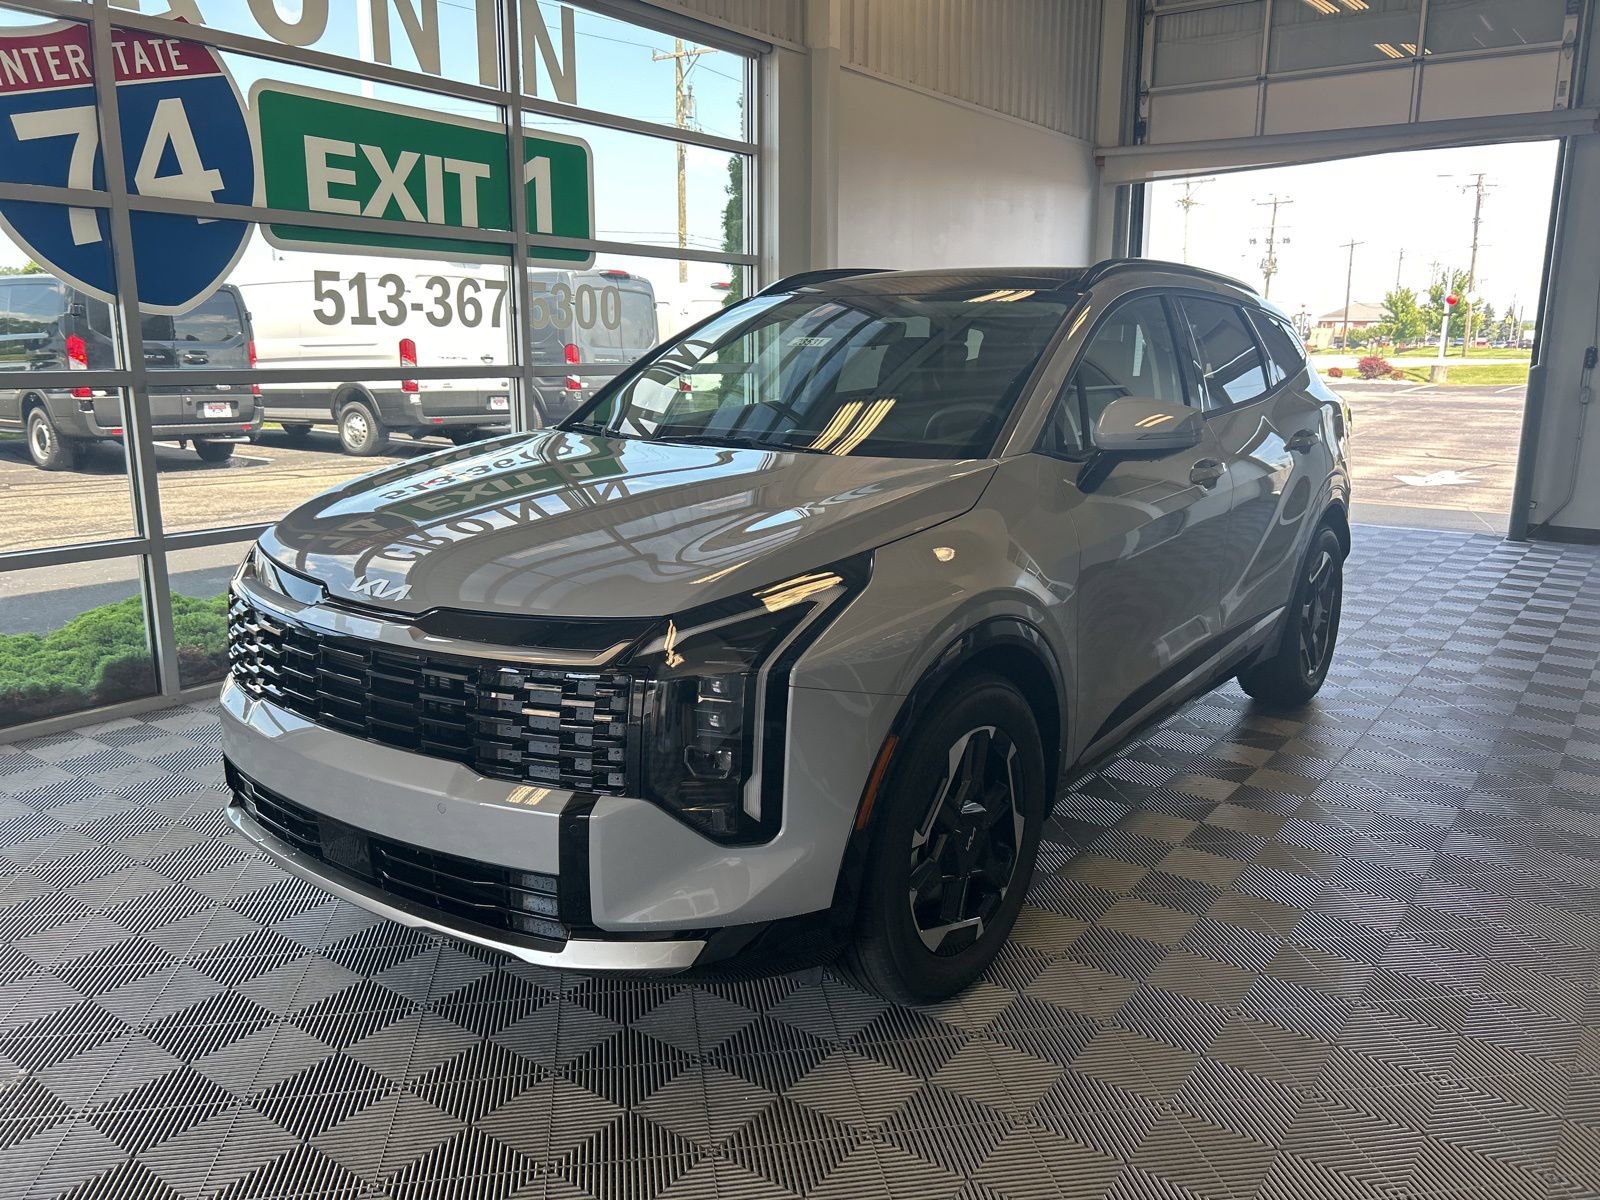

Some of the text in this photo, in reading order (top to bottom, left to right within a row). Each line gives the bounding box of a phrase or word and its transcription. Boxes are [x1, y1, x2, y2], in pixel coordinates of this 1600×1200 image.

[0, 39, 188, 86] NTERTATE
[10, 98, 224, 246] 74
[304, 135, 553, 234] EXIT 1
[313, 270, 621, 331] 513-3675300
[349, 576, 413, 602] KIA
